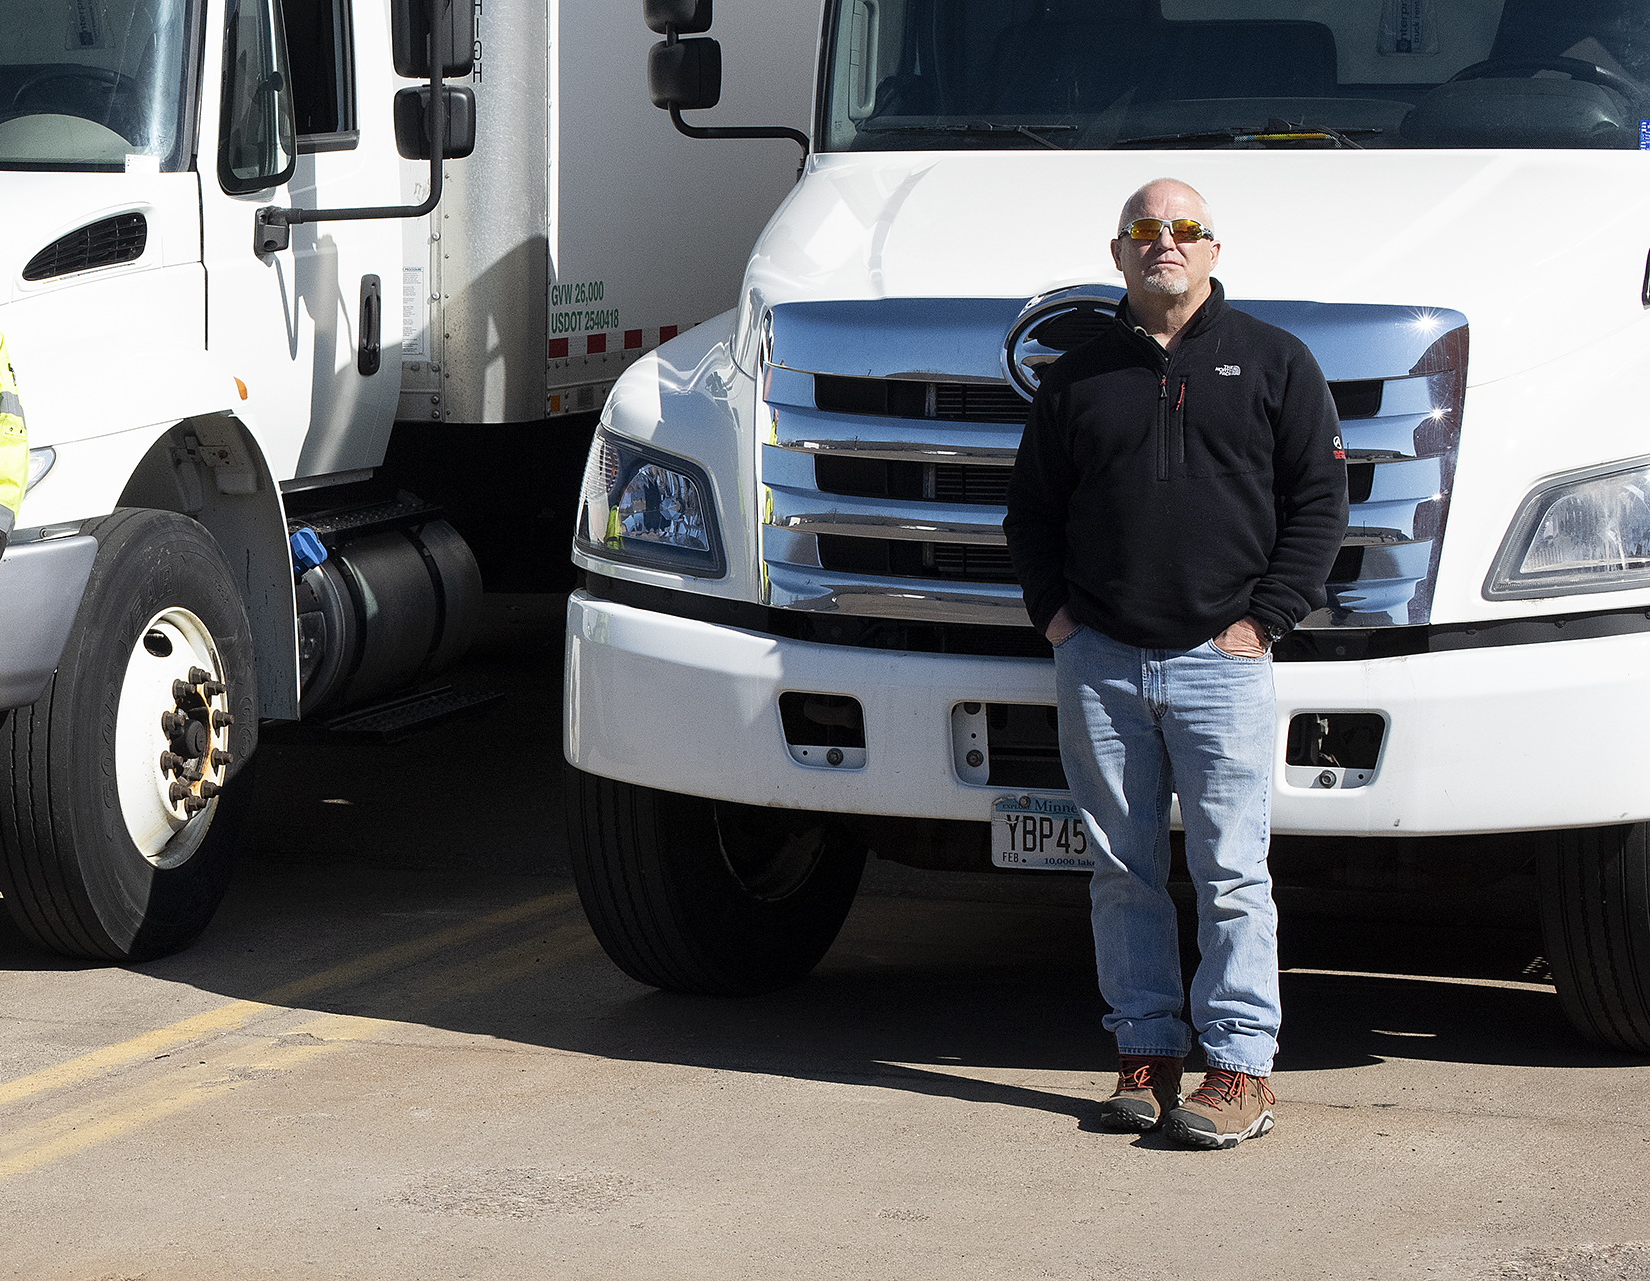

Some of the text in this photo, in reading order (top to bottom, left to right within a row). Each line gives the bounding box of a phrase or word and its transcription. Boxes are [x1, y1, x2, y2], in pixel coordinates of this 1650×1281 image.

[551, 281, 604, 306] GVW 26,000
[551, 308, 619, 334] USDOT 2540418
[1006, 814, 1088, 855] YBP45
[1002, 852, 1019, 862] FEB
[1044, 858, 1075, 866] 10,000
